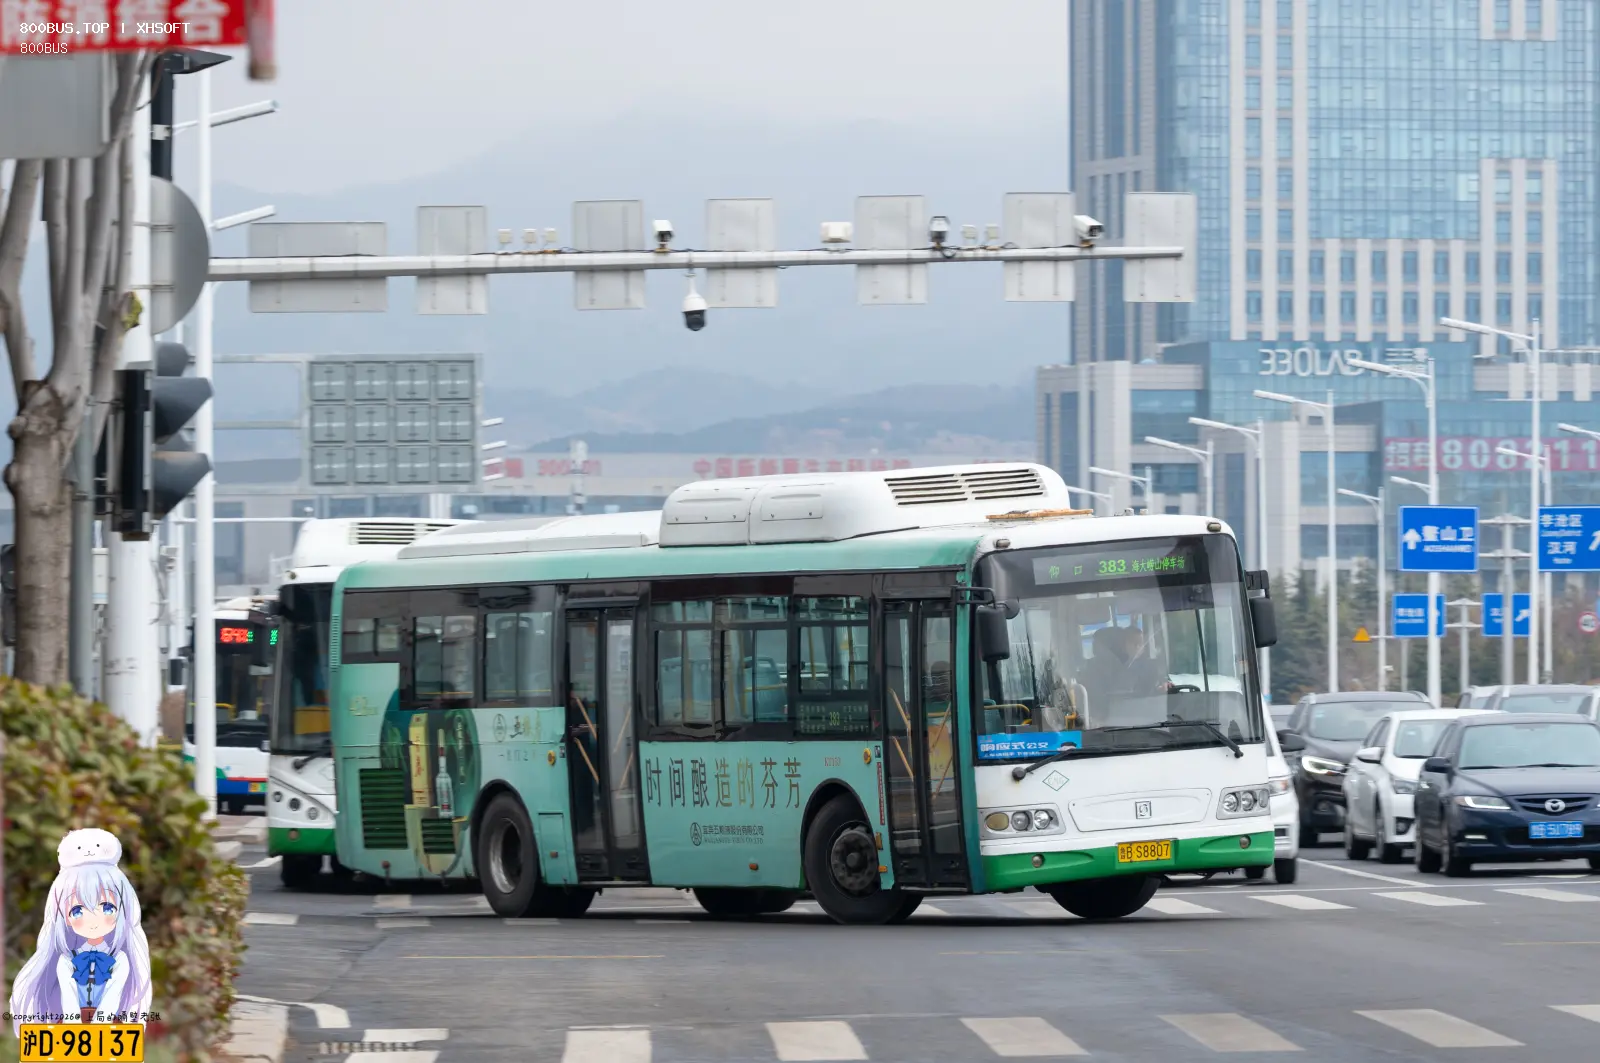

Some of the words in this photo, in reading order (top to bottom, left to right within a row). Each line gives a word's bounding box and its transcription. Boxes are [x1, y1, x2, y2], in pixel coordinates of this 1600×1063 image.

[1099, 559, 1127, 573] 383
[645, 757, 801, 808] 时间酿造的芬芳
